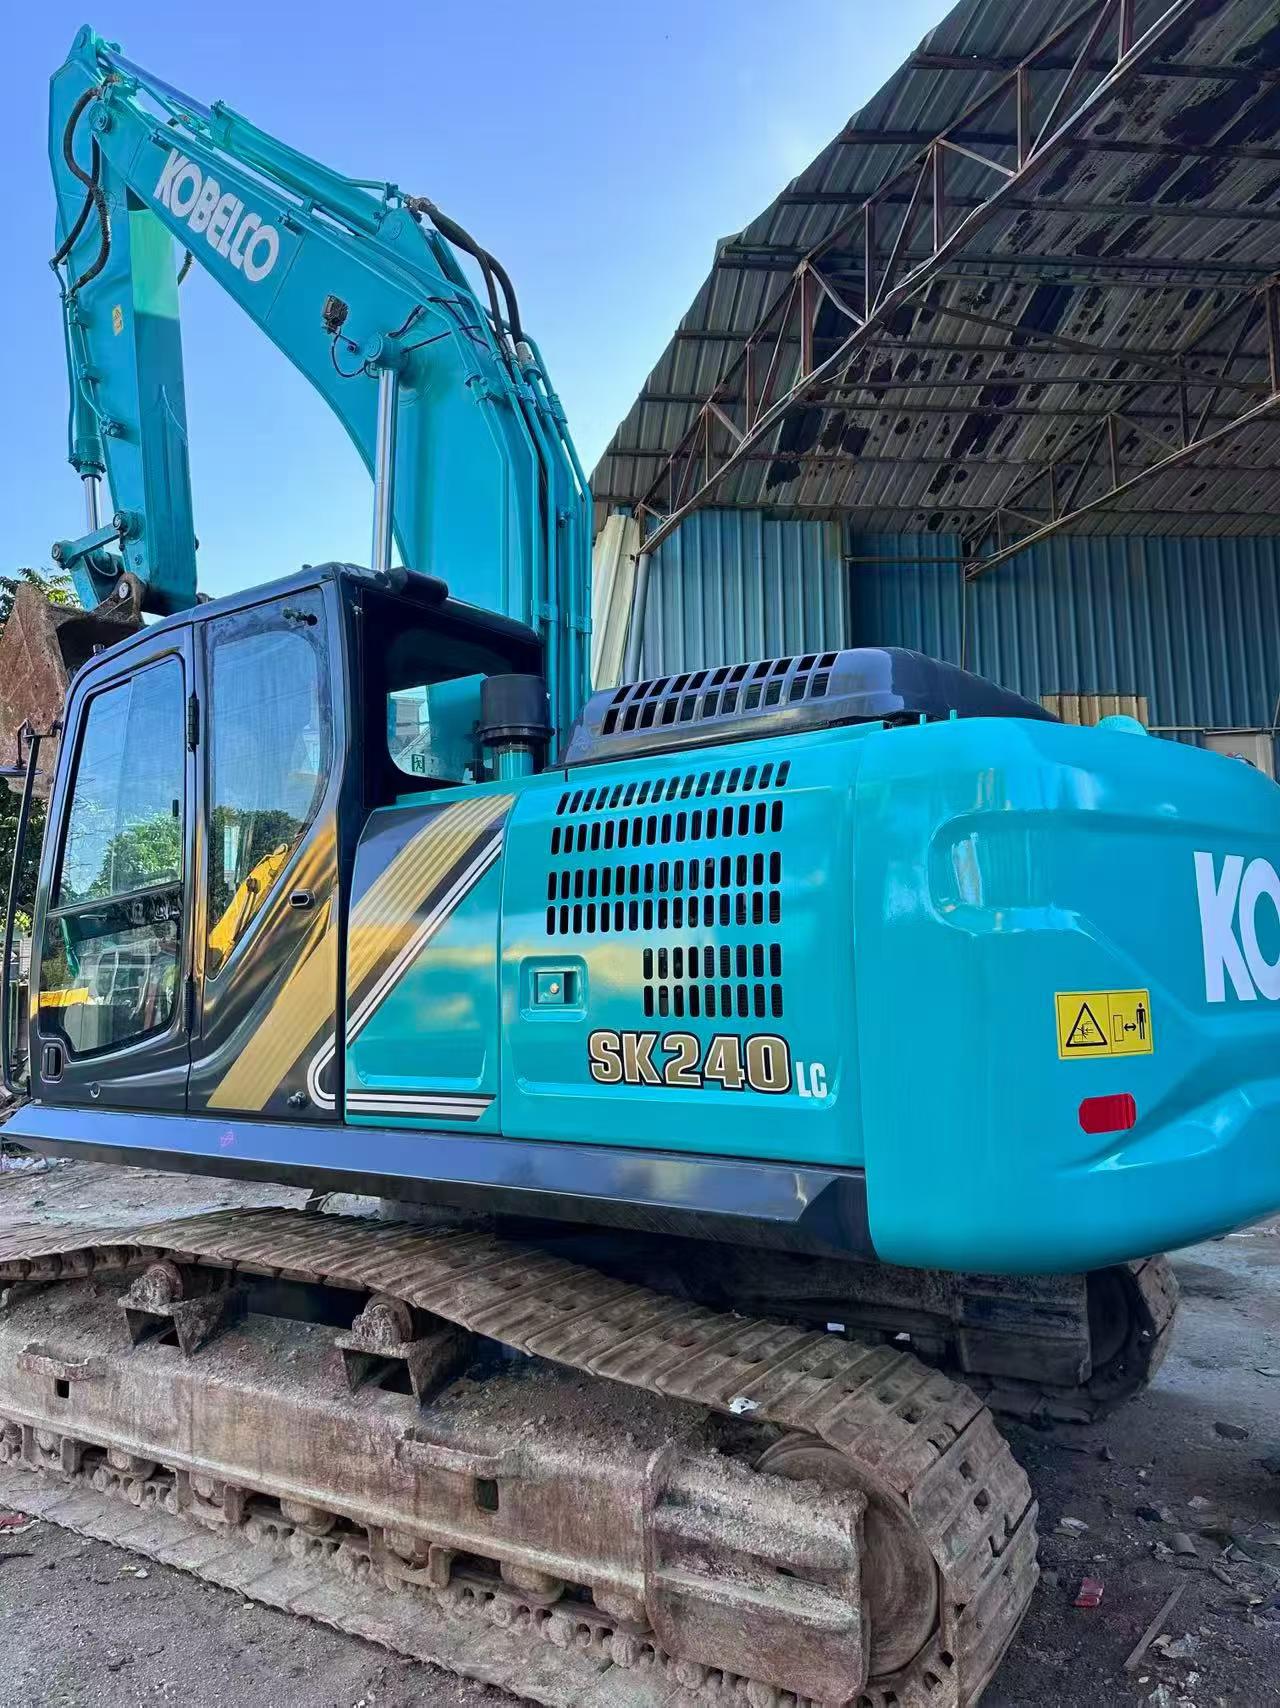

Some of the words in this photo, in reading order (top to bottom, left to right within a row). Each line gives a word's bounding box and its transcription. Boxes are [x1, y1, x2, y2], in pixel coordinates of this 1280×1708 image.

[153, 148, 279, 282] KOBELCO
[588, 1029, 793, 1094] SK240
[795, 1062, 828, 1098] LC
